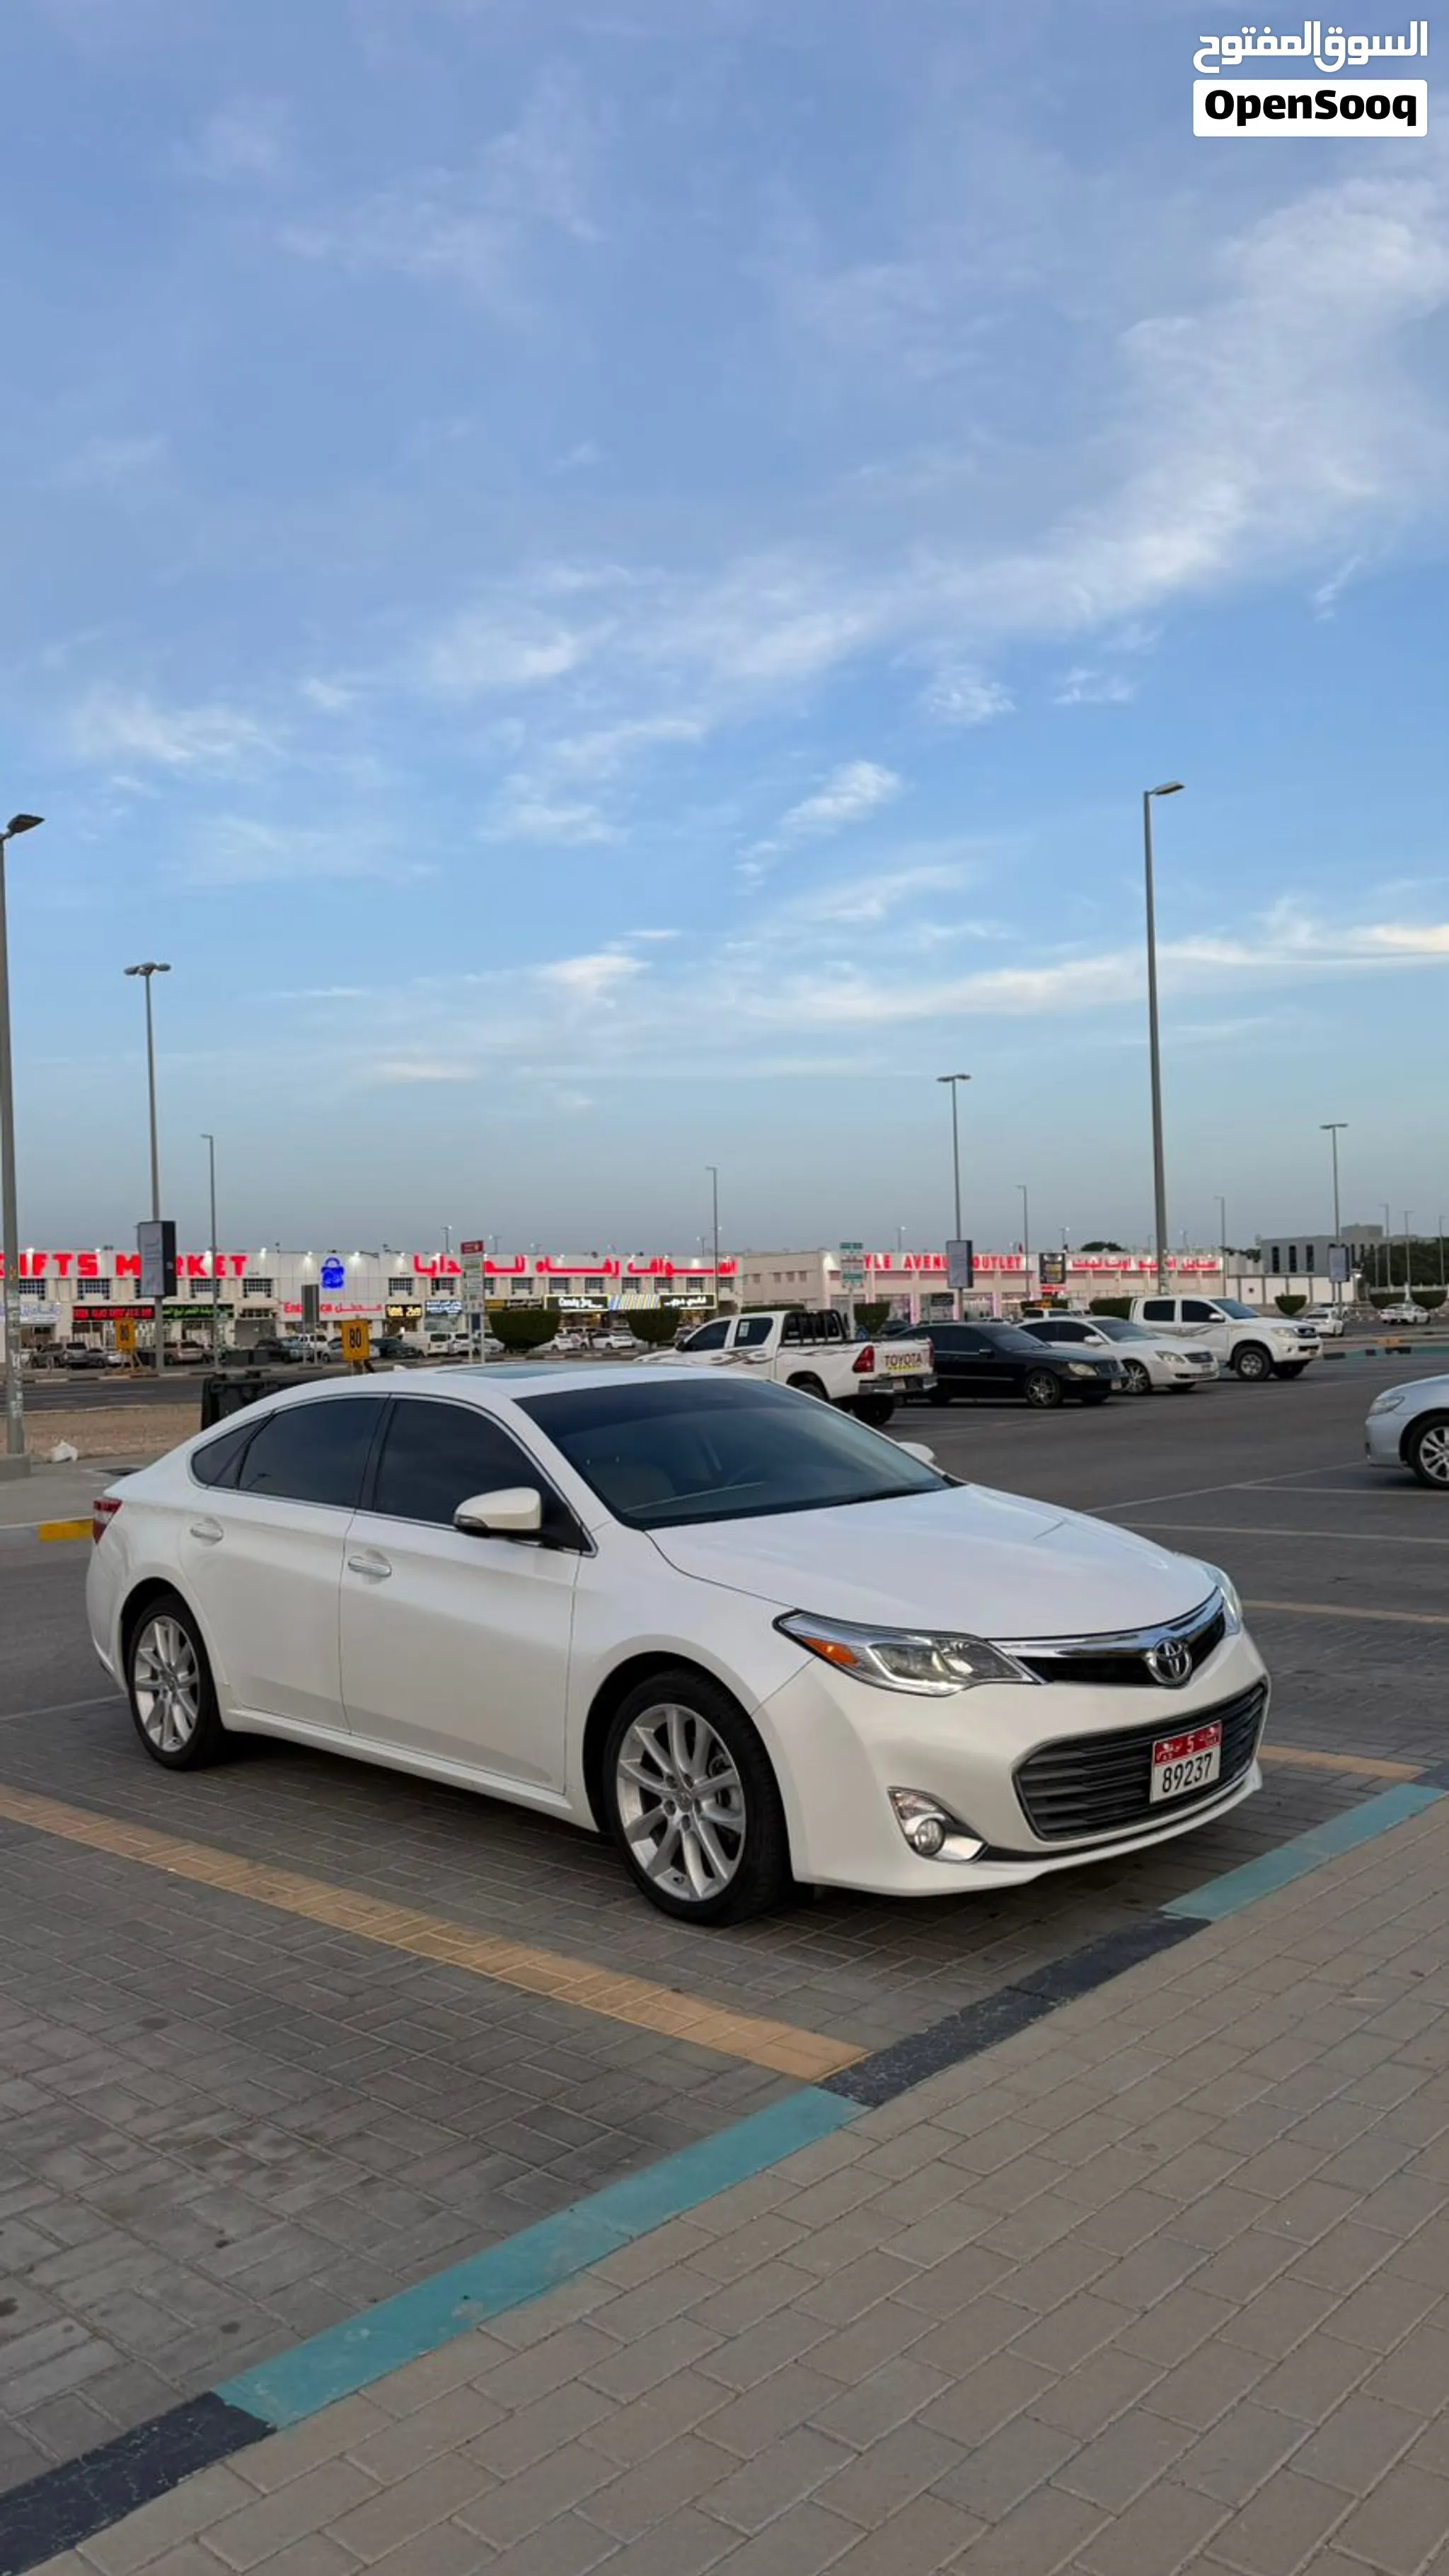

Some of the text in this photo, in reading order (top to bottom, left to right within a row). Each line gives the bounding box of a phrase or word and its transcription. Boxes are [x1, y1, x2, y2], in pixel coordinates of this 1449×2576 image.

[0, 1252, 246, 1277] IFTS MKET
[864, 1253, 891, 1270] YLE
[904, 1253, 949, 1270] AVENU
[349, 1327, 362, 1349] 80
[884, 1352, 923, 1366] TOYOTA
[1187, 1735, 1195, 1753] 5
[1162, 1751, 1213, 1793] 89237
